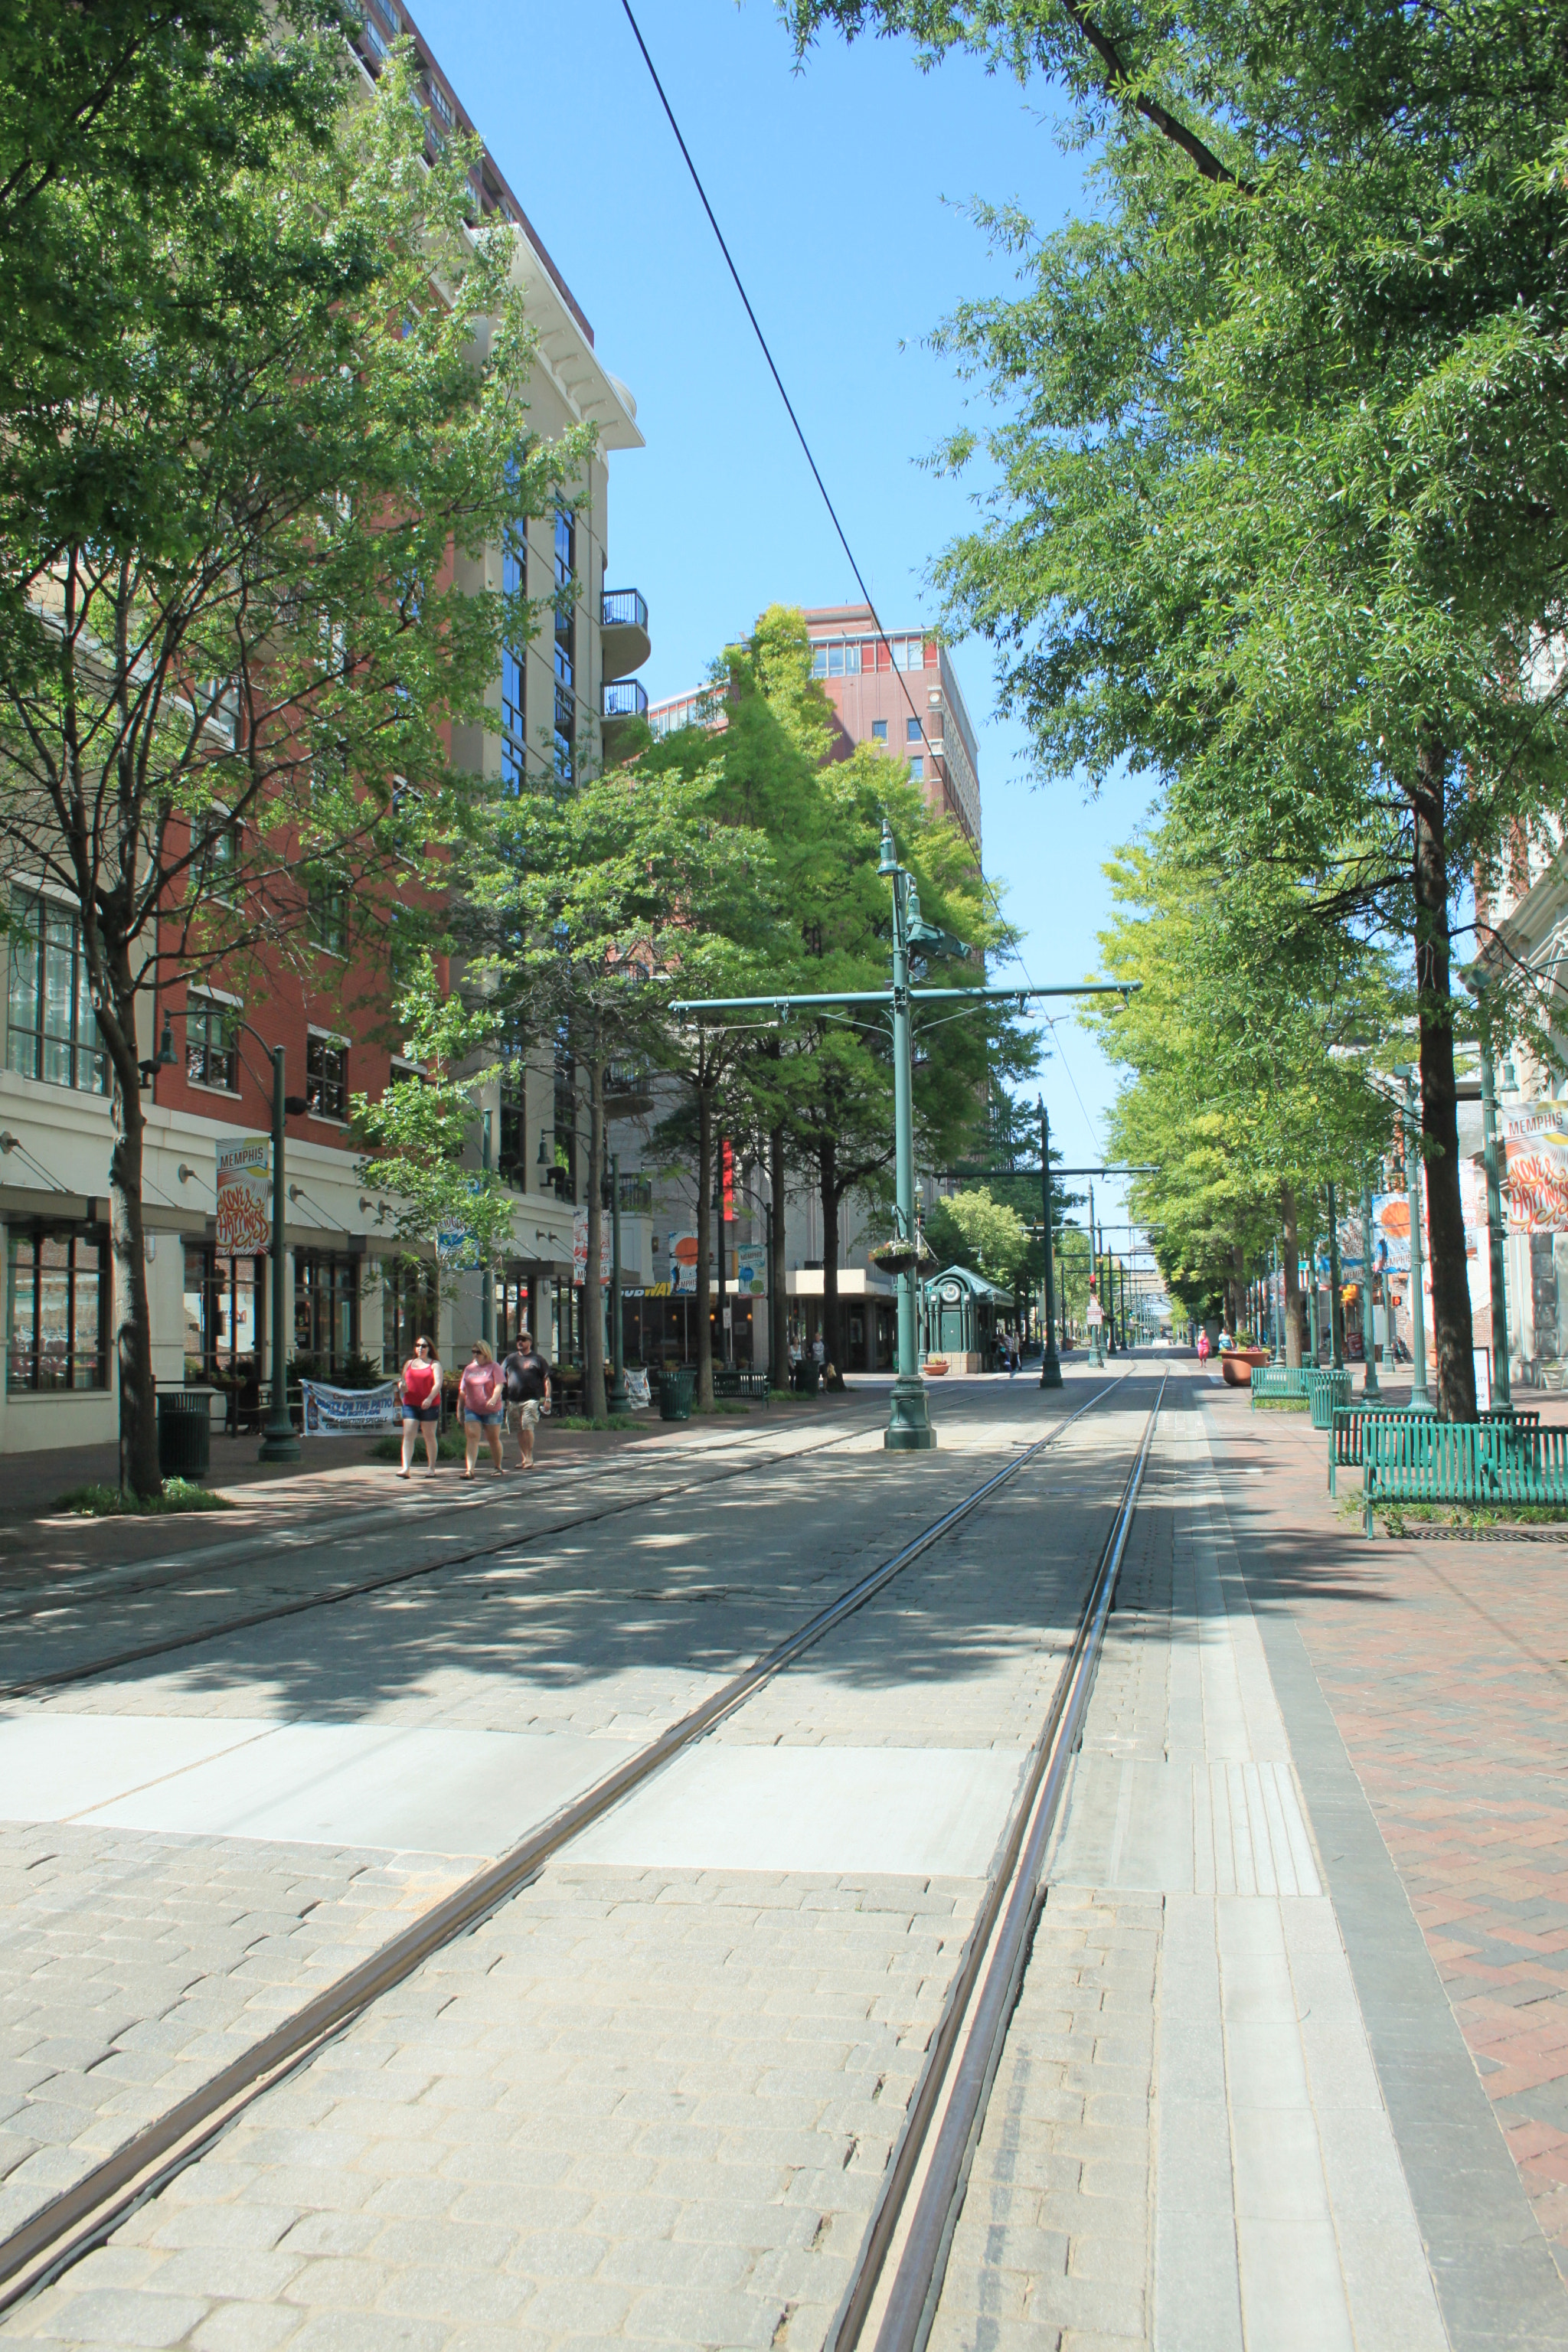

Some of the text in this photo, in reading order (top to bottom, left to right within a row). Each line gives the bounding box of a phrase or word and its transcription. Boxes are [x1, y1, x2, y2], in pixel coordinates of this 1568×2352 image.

[1508, 1112, 1563, 1136] MEMPHIS
[220, 1148, 263, 1168] MEMPHIS
[1508, 1155, 1544, 1187] LOVE
[620, 1282, 671, 1297] UBWAY
[371, 1397, 393, 1409] PATIO
